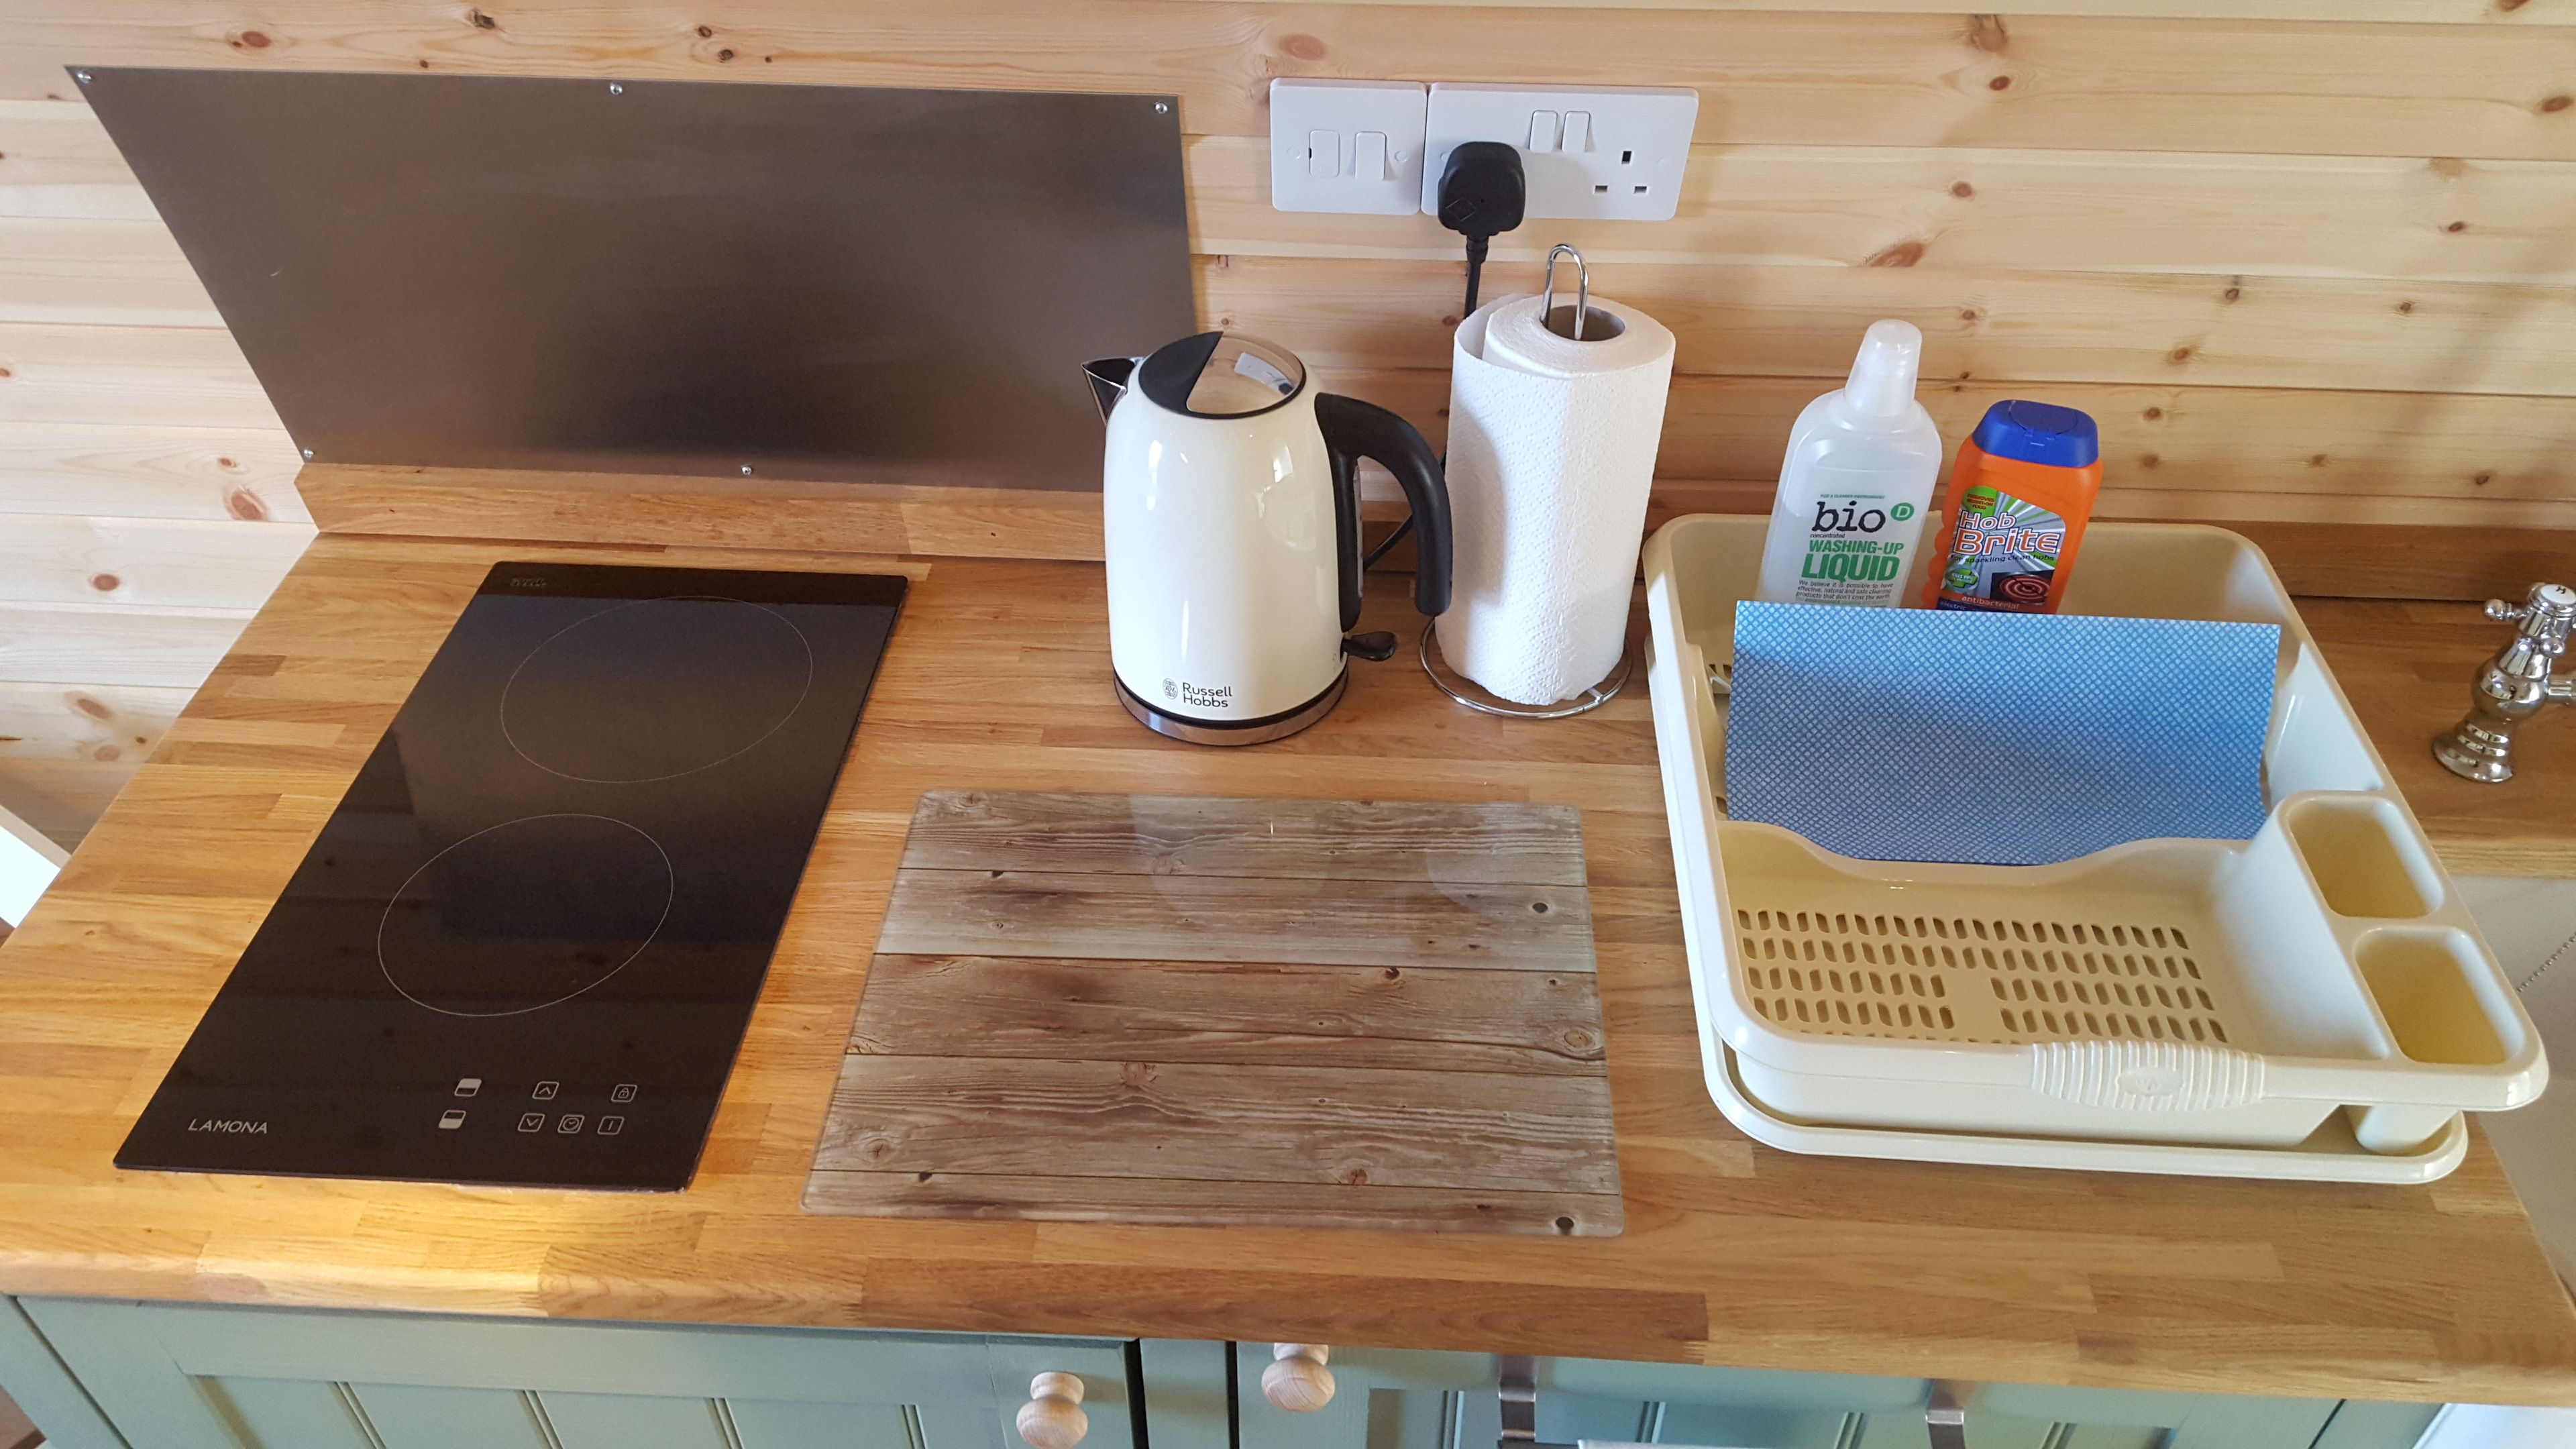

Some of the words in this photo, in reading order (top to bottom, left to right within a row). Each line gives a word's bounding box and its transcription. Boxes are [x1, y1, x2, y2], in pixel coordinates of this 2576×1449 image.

[1811, 500, 1886, 533] bio
[1960, 510, 2016, 530] Hob
[1809, 539, 1904, 555] WASHING-UP
[1953, 527, 2061, 555] Brite
[1801, 553, 1900, 582] LIQUID
[1950, 554, 1963, 562] for
[1965, 556, 2006, 566] sparkling
[1962, 595, 2019, 610] antibacterial
[1183, 682, 1232, 697] Russell
[1183, 693, 1228, 708] Hobbs
[188, 1118, 268, 1134] LAMONA
